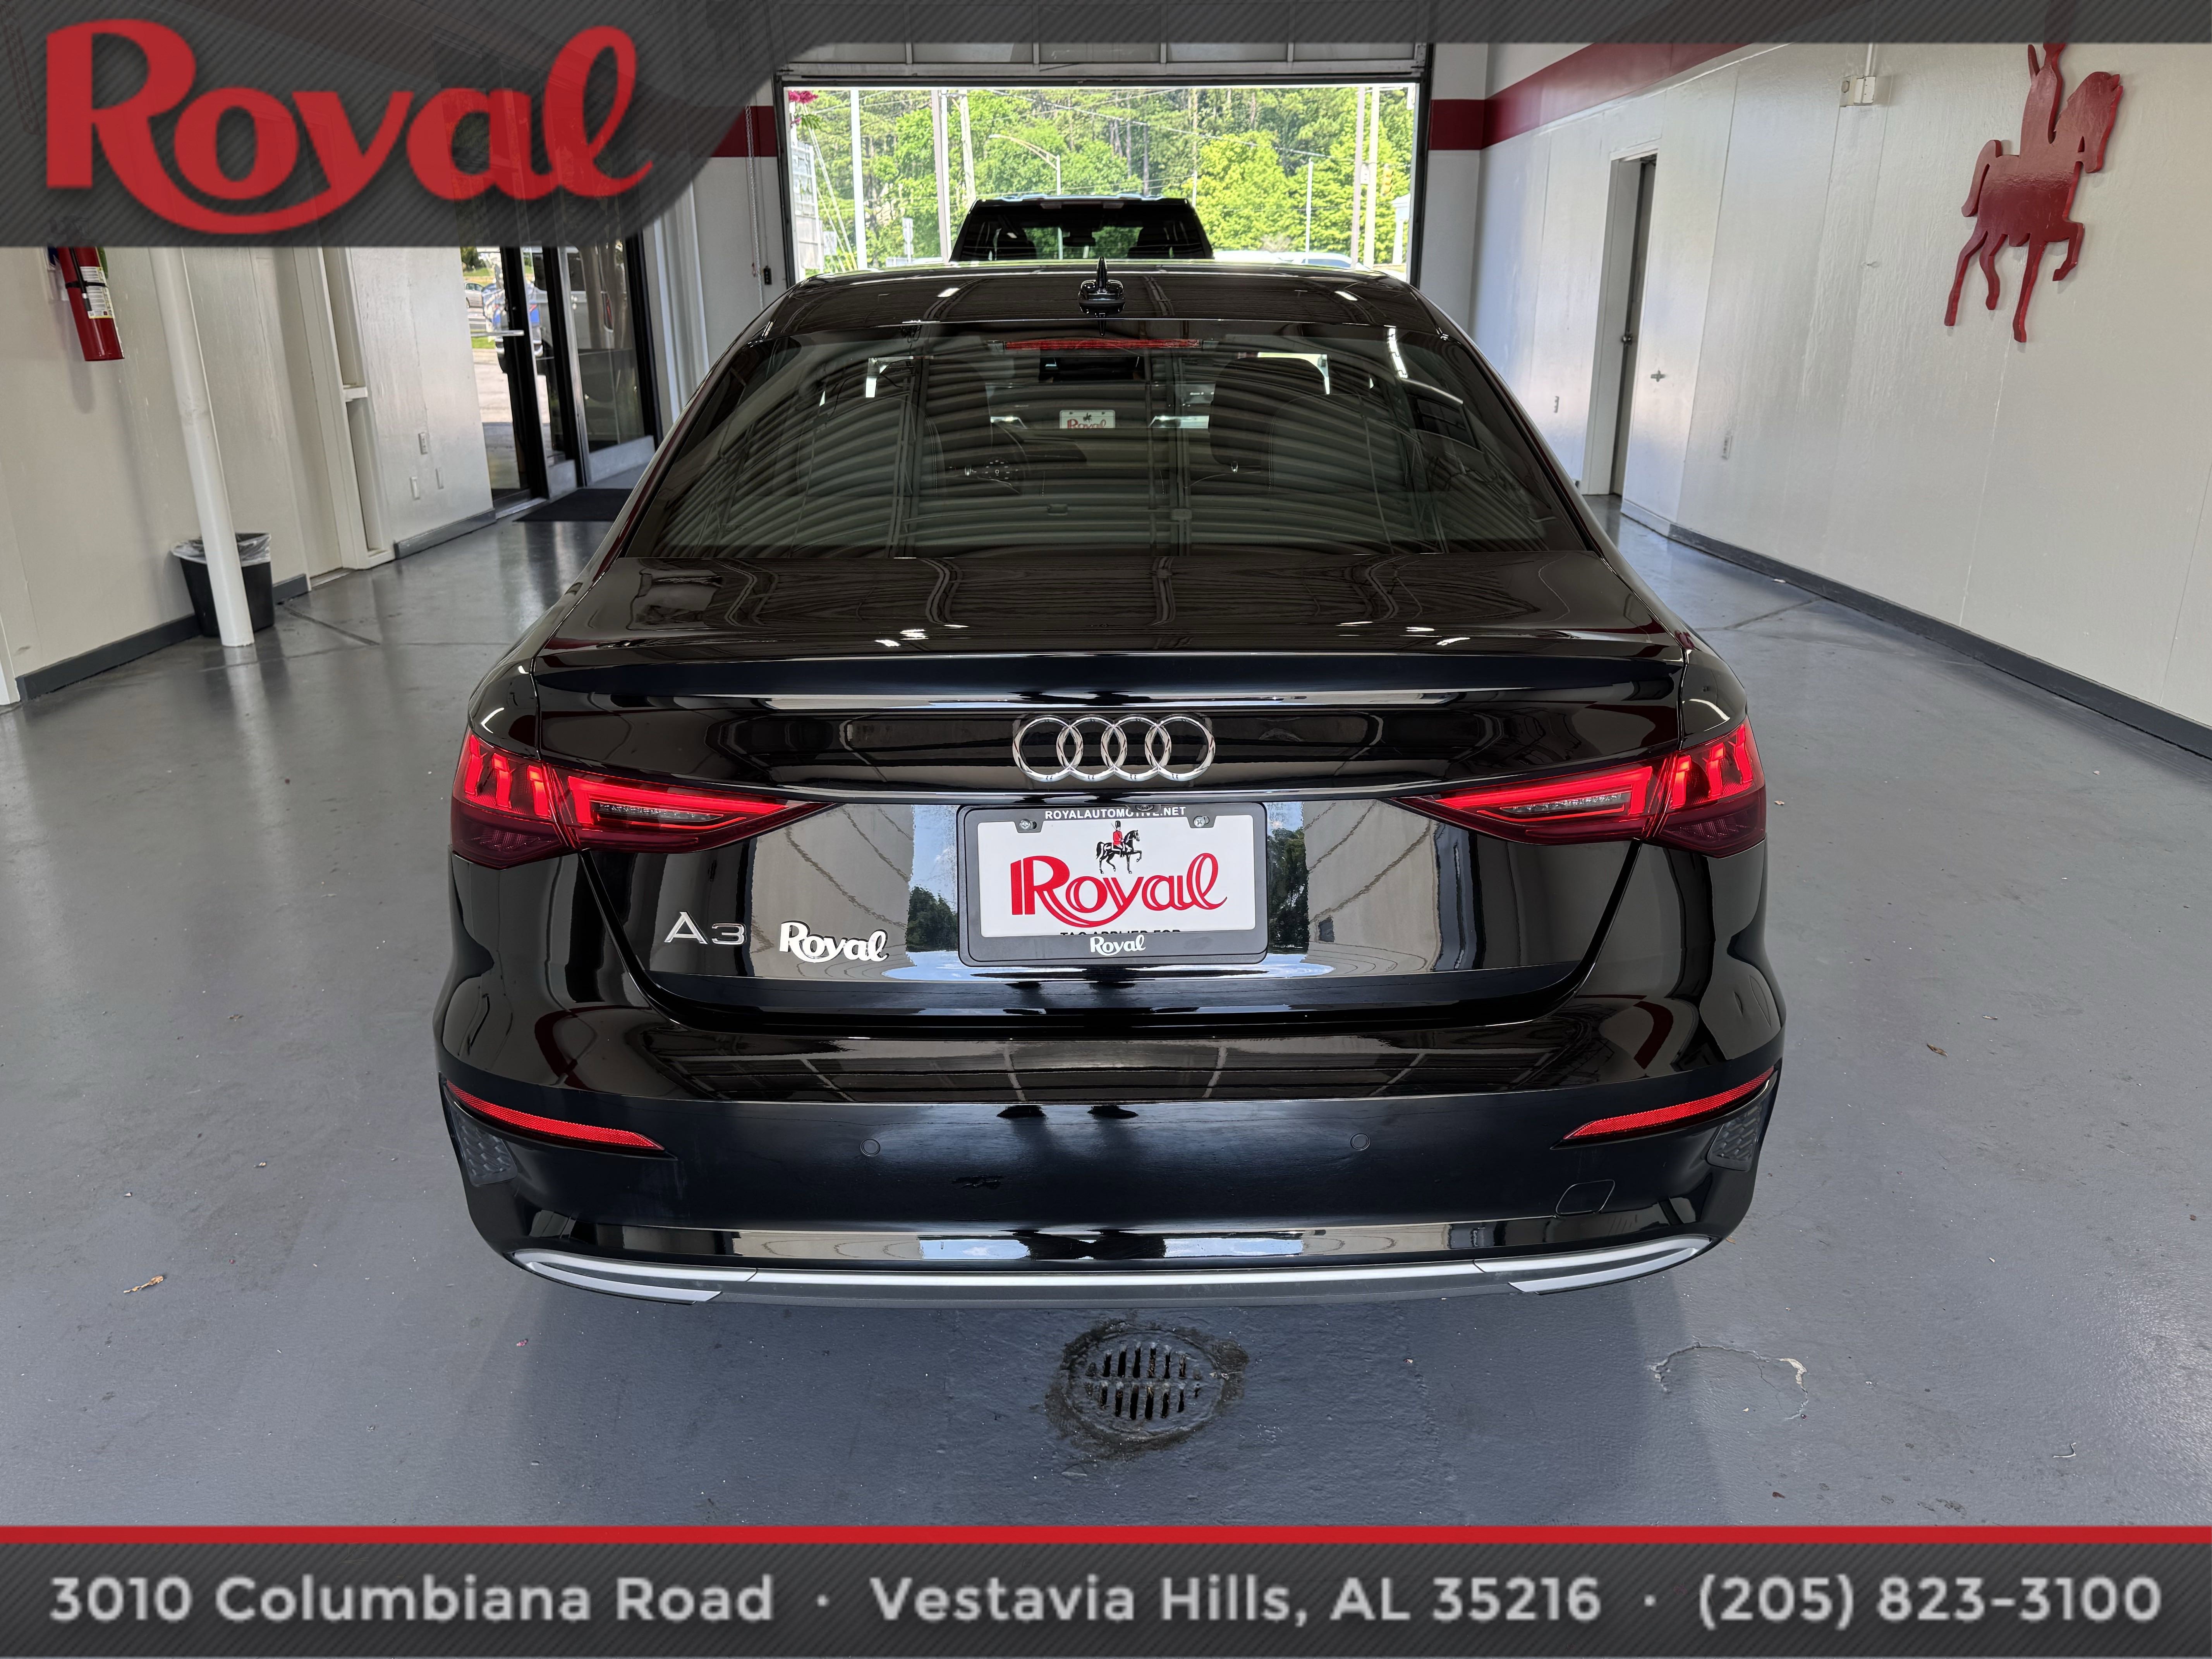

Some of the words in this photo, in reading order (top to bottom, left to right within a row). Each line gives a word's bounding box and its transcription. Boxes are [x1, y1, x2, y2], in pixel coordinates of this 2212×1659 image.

[1010, 853, 1228, 928] Royal
[664, 911, 745, 945] A3
[779, 921, 889, 963] Royal
[1090, 934, 1147, 956] Royal
